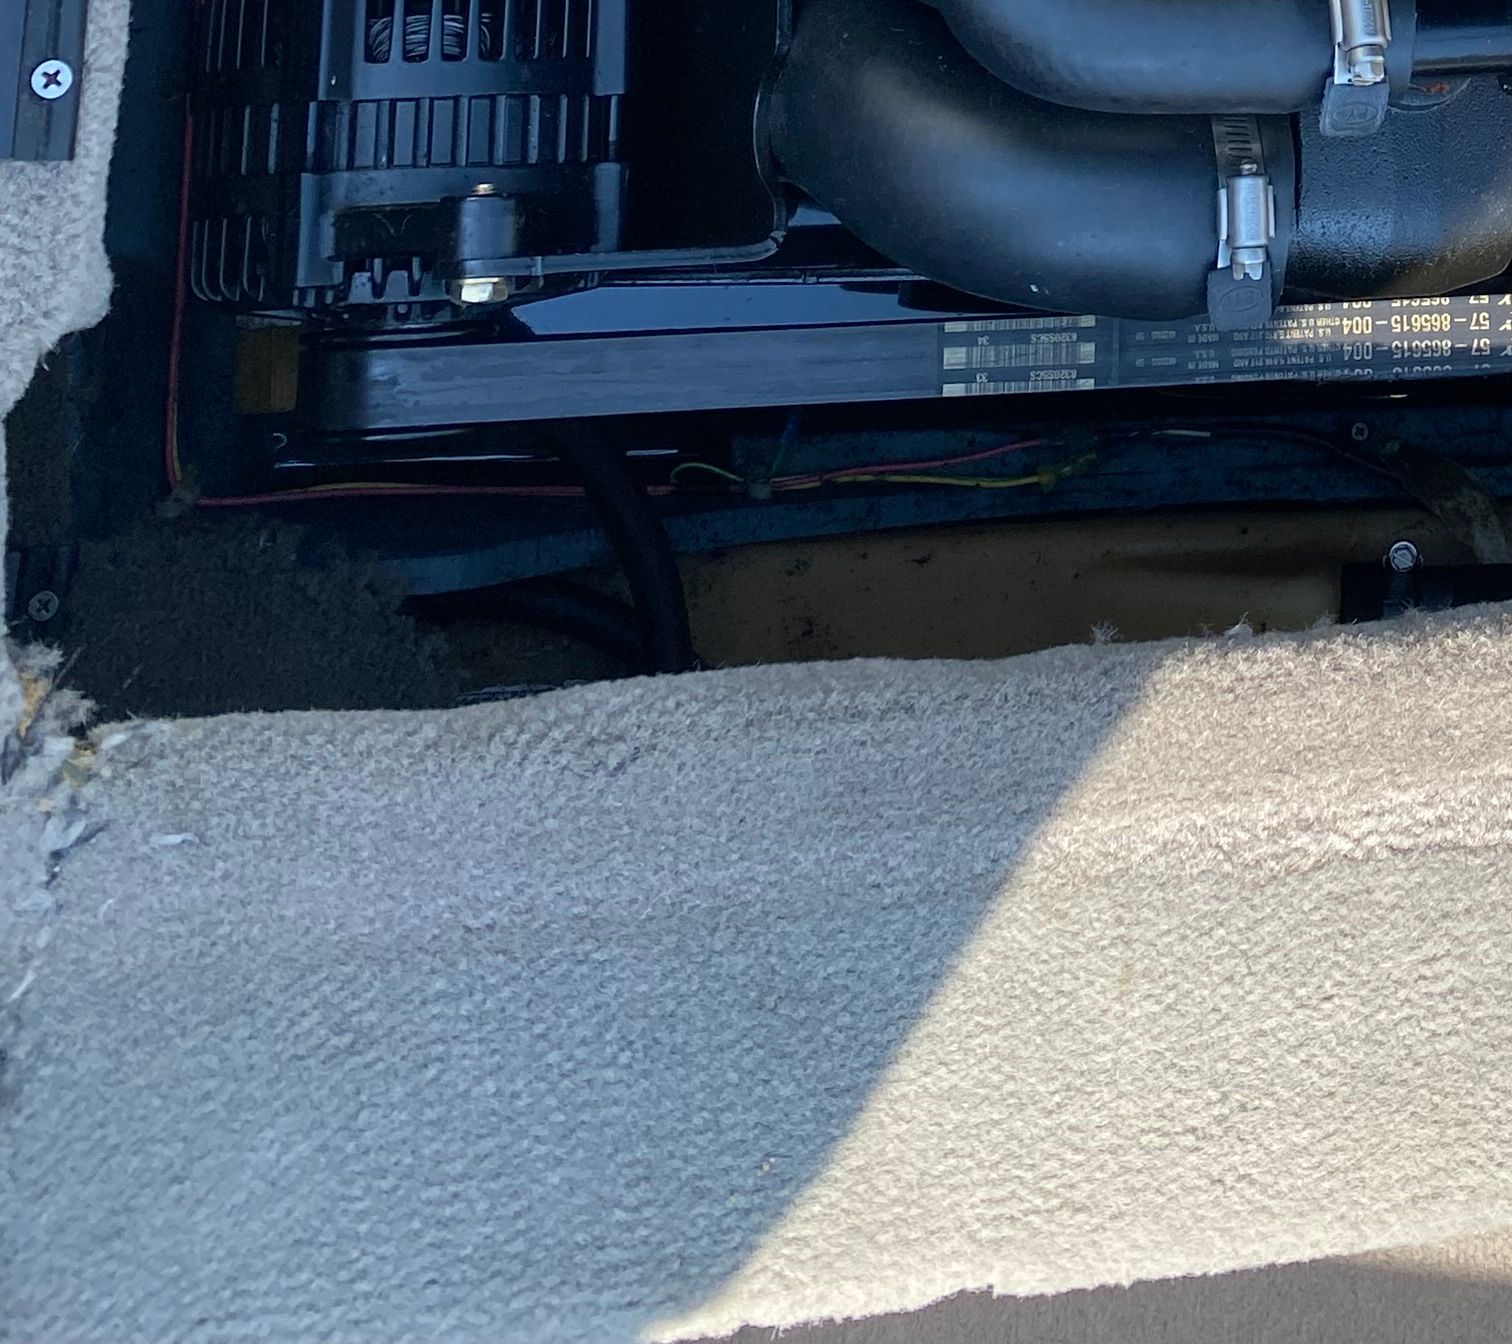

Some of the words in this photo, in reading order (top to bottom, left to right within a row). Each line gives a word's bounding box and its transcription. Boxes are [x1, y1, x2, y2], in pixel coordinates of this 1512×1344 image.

[1286, 329, 1314, 339] PATENT
[977, 335, 989, 345] 34
[1198, 360, 1219, 369] MADE
[1286, 355, 1314, 365] PATENT
[976, 372, 989, 383] 33
